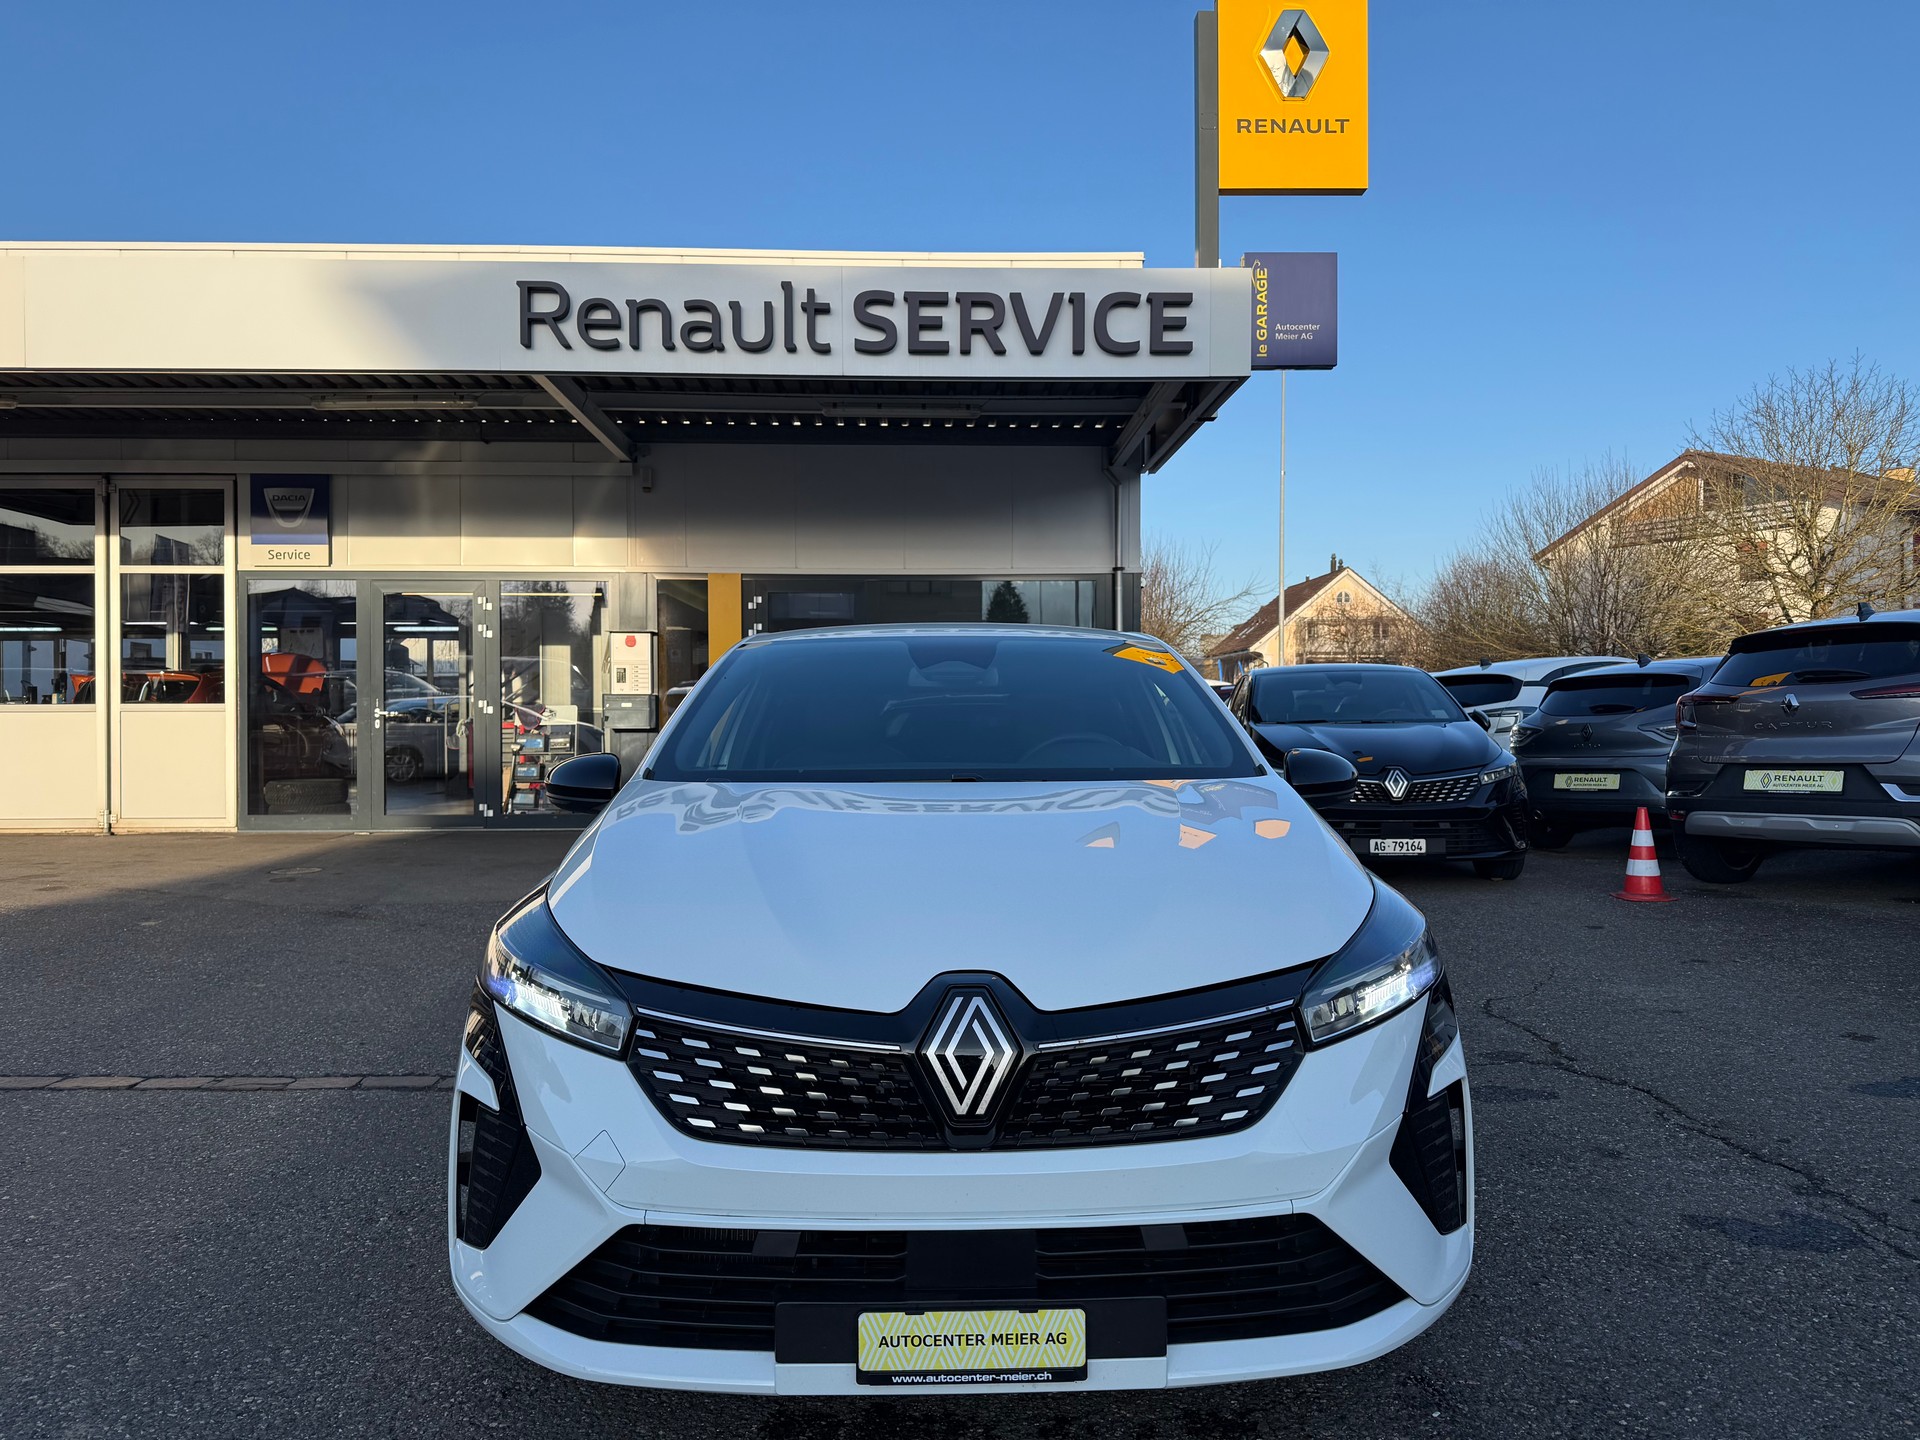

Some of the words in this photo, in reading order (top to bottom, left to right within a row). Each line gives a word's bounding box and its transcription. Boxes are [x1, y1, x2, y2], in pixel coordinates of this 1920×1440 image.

[1236, 118, 1350, 134] RENAULT
[1256, 267, 1268, 341] GARAGE
[516, 280, 832, 354] Renault
[853, 289, 1194, 357] SERVICE
[1275, 323, 1320, 331] Autocenter
[1256, 344, 1268, 357] le
[272, 494, 306, 502] DACIA
[267, 548, 311, 560] Service
[1754, 721, 1833, 730] CAPTUR
[1774, 774, 1824, 782] RENAULT
[1373, 841, 1386, 851] AG
[1392, 841, 1423, 851] 79164
[878, 1334, 986, 1348] AUTOCENTER
[991, 1332, 1040, 1346] MEIER
[1045, 1332, 1067, 1345] AG
[892, 1371, 1052, 1383] www.autocenter-meier.ch
